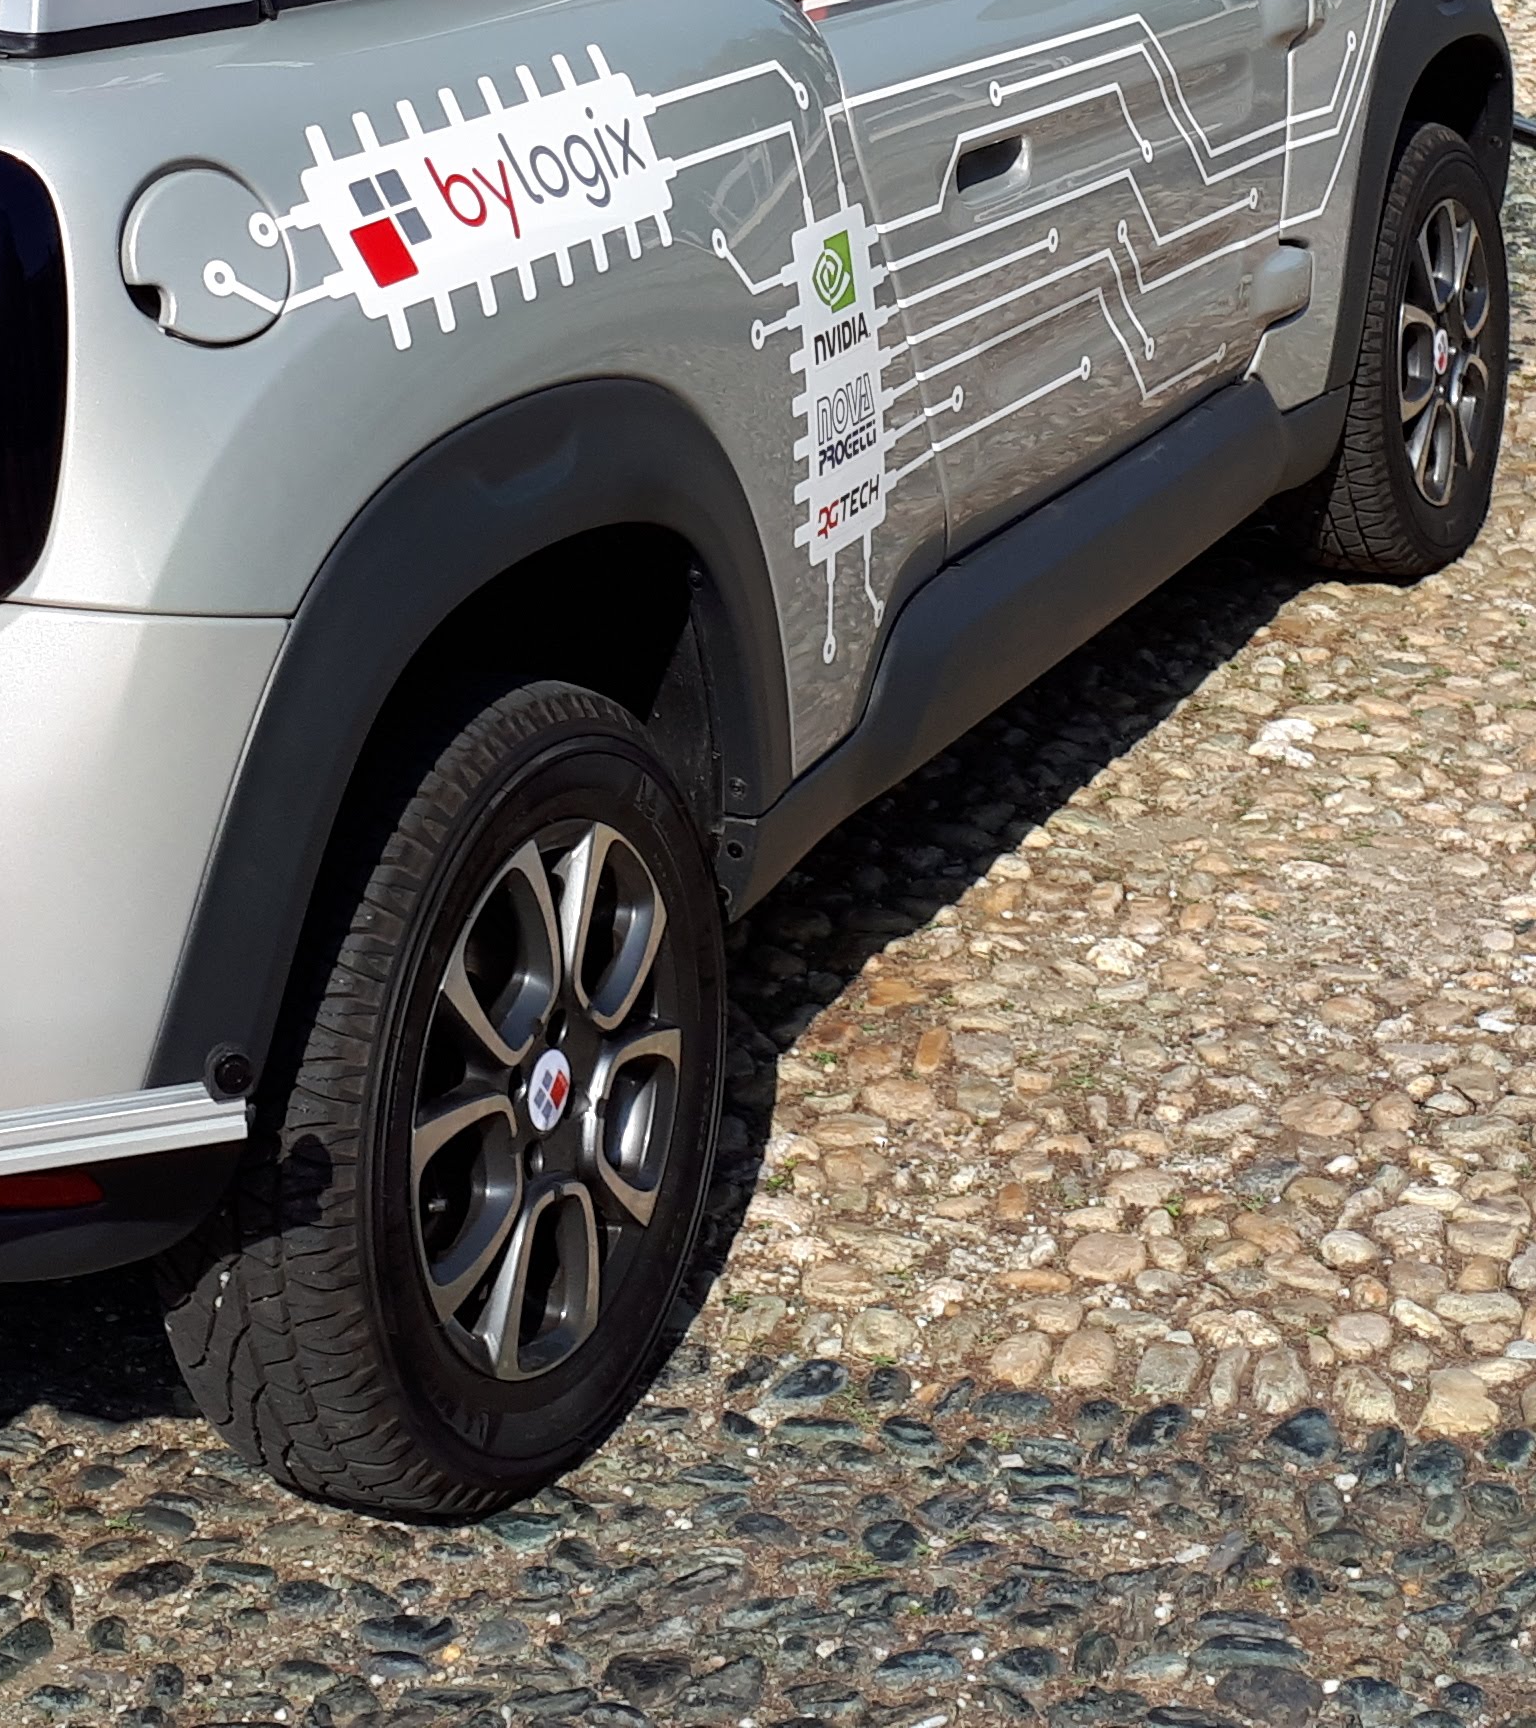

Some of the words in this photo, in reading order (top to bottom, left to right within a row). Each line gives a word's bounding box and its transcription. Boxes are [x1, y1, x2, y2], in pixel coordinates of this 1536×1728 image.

[423, 106, 647, 239] bylogix
[813, 312, 871, 365] NVIDIA
[816, 372, 876, 446] NOVA
